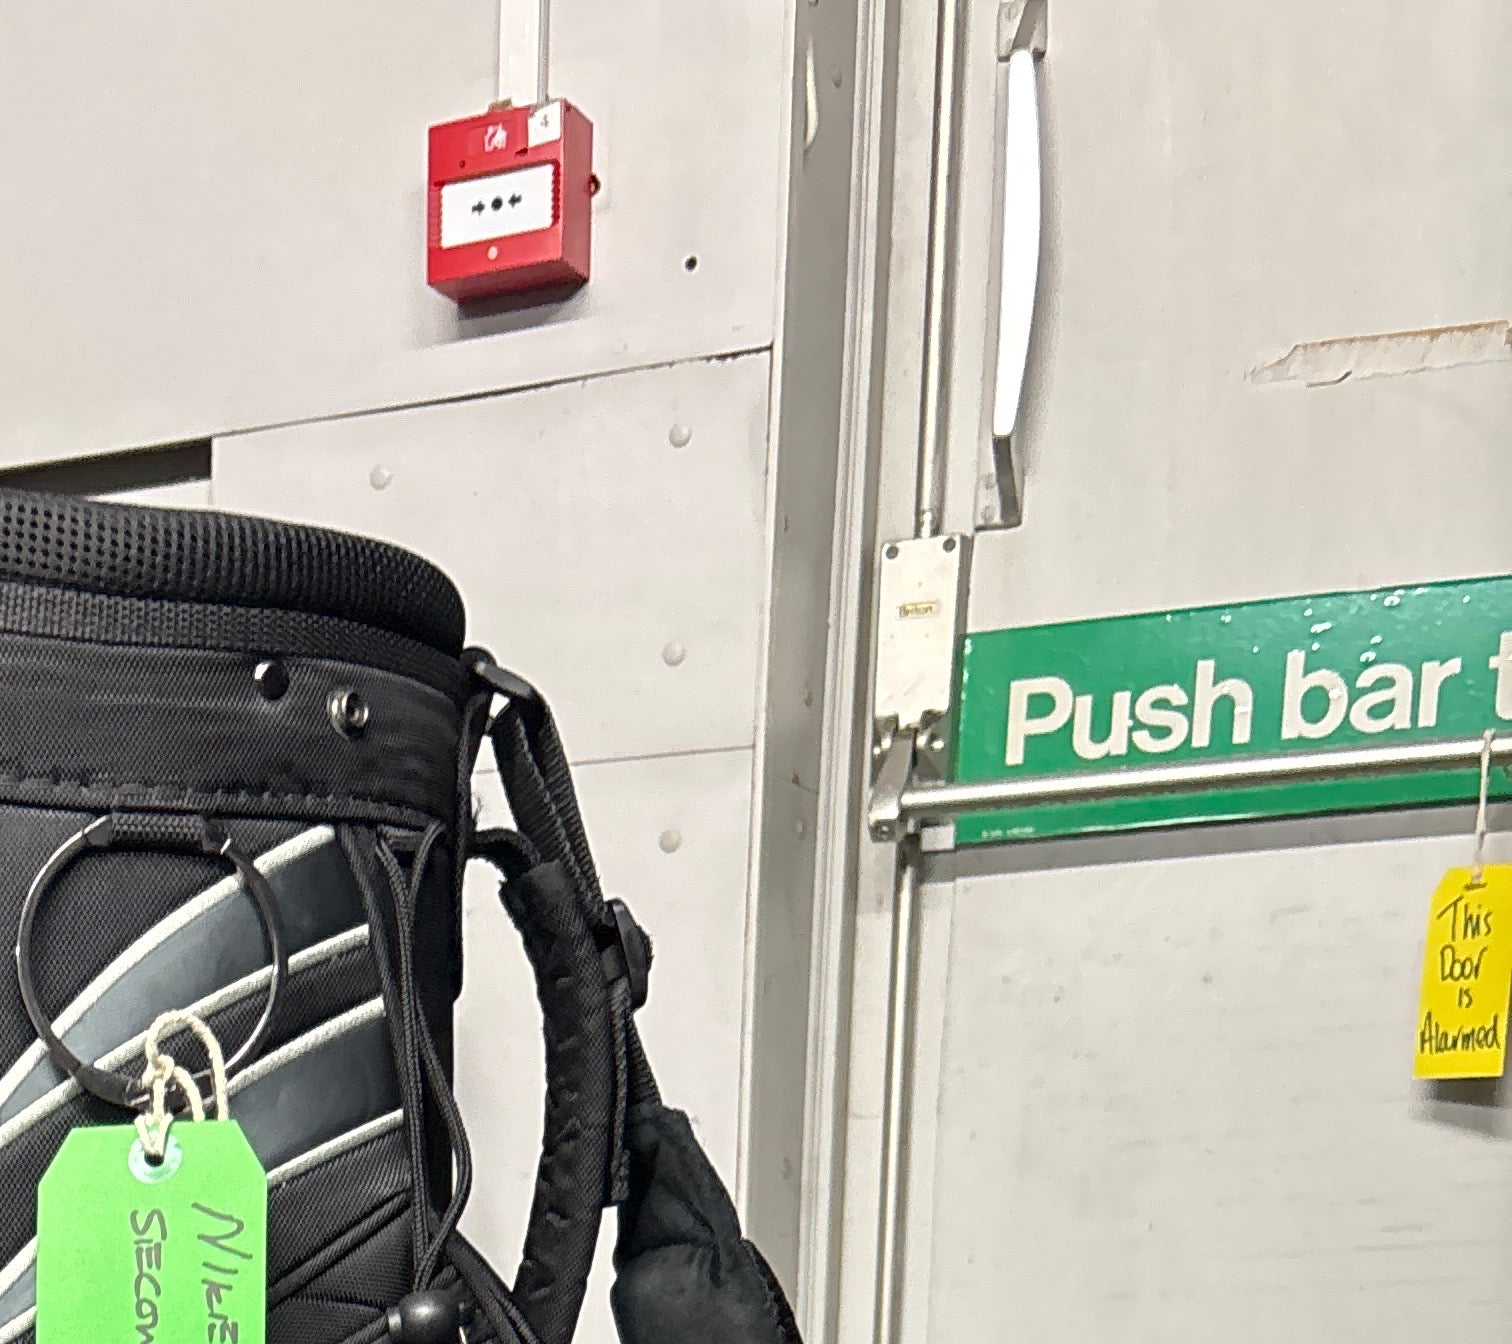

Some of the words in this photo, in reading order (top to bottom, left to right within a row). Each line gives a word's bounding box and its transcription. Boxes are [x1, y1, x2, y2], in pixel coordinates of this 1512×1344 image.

[1005, 660, 1253, 766] Push
[1281, 649, 1462, 739] bar
[1436, 894, 1493, 942] This
[1440, 944, 1488, 982] Door
[1419, 1011, 1501, 1056] Alarmed
